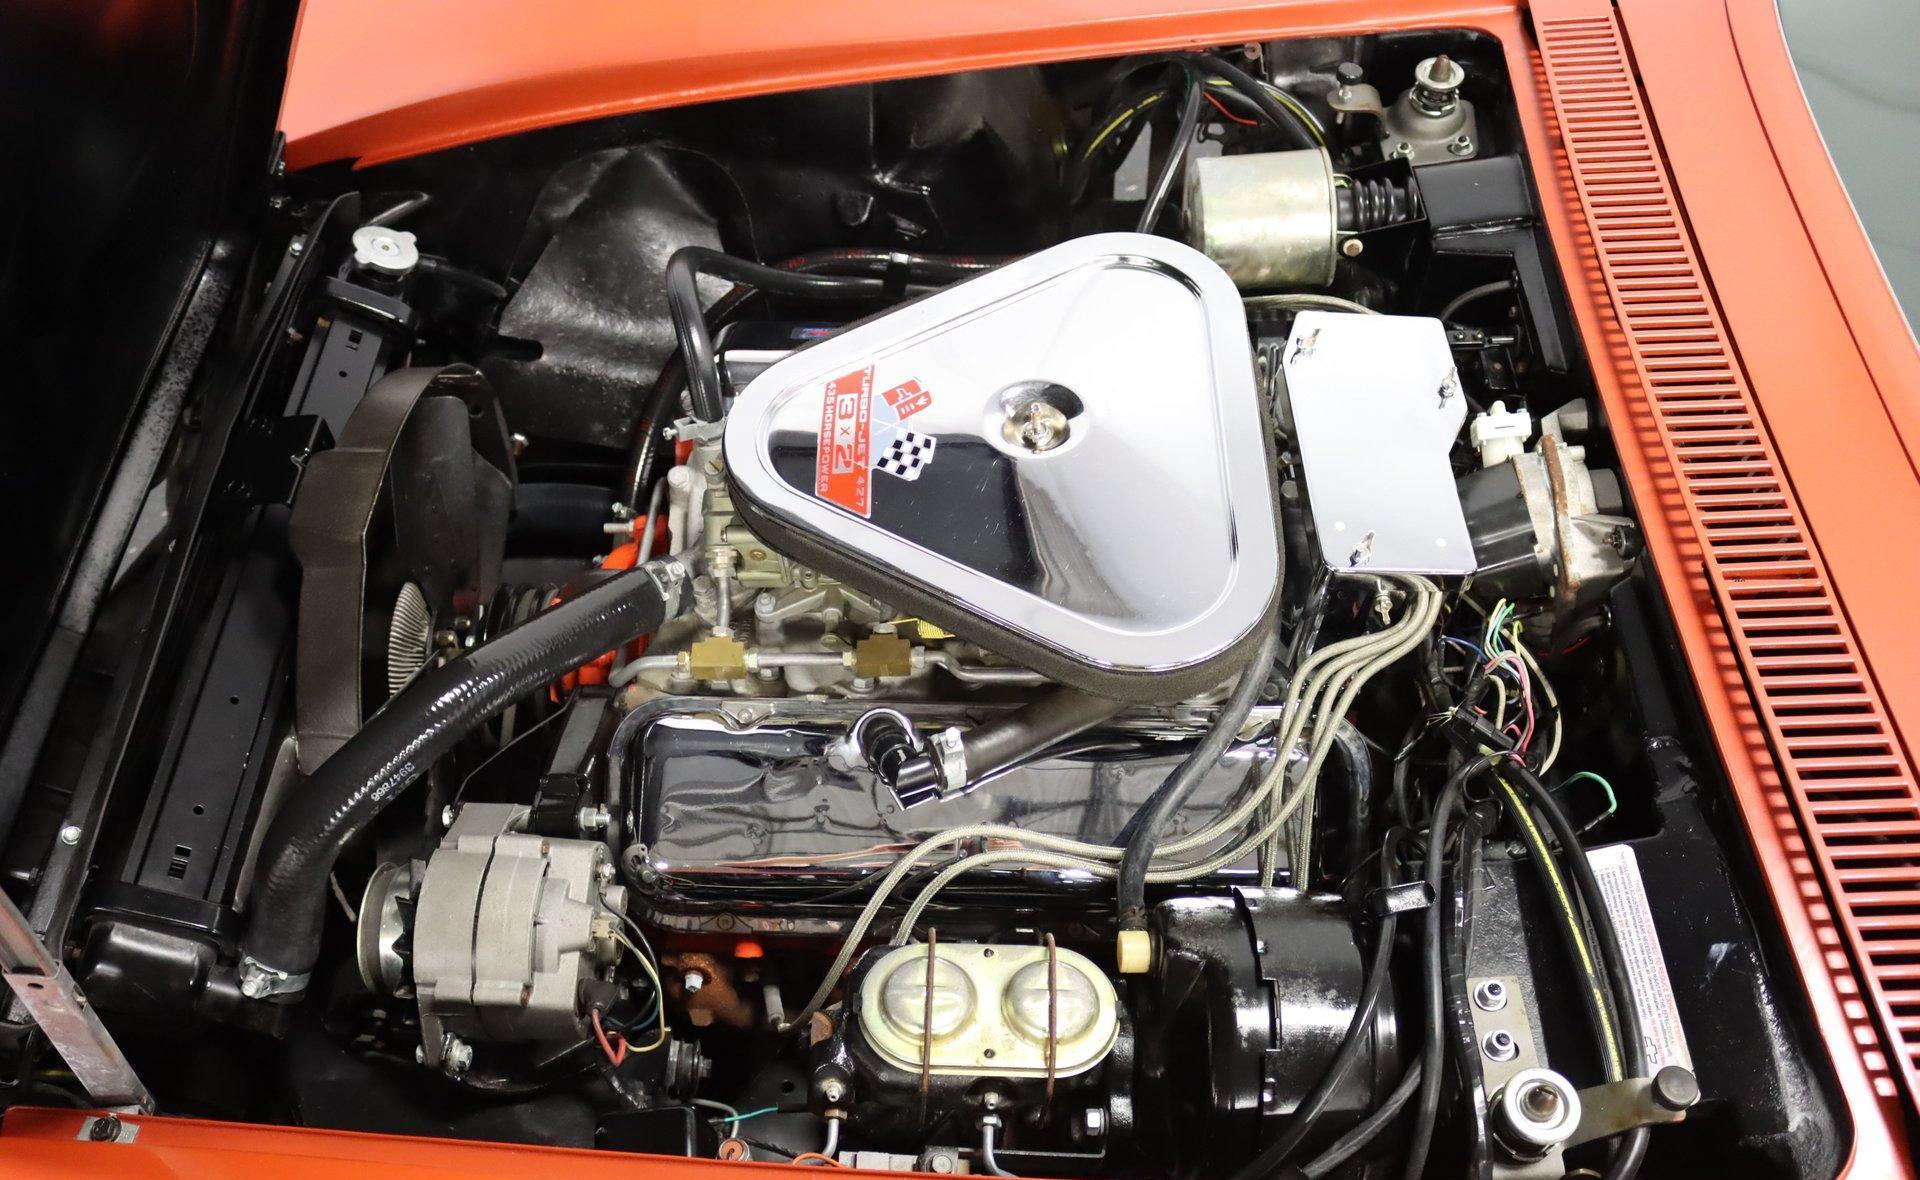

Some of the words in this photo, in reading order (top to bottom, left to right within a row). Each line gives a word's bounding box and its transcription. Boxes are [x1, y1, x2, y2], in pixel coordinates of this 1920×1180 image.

[839, 398, 854, 420] 3
[819, 406, 836, 493] HORSEPOWER
[834, 444, 853, 470] 2
[856, 475, 865, 507] 427
